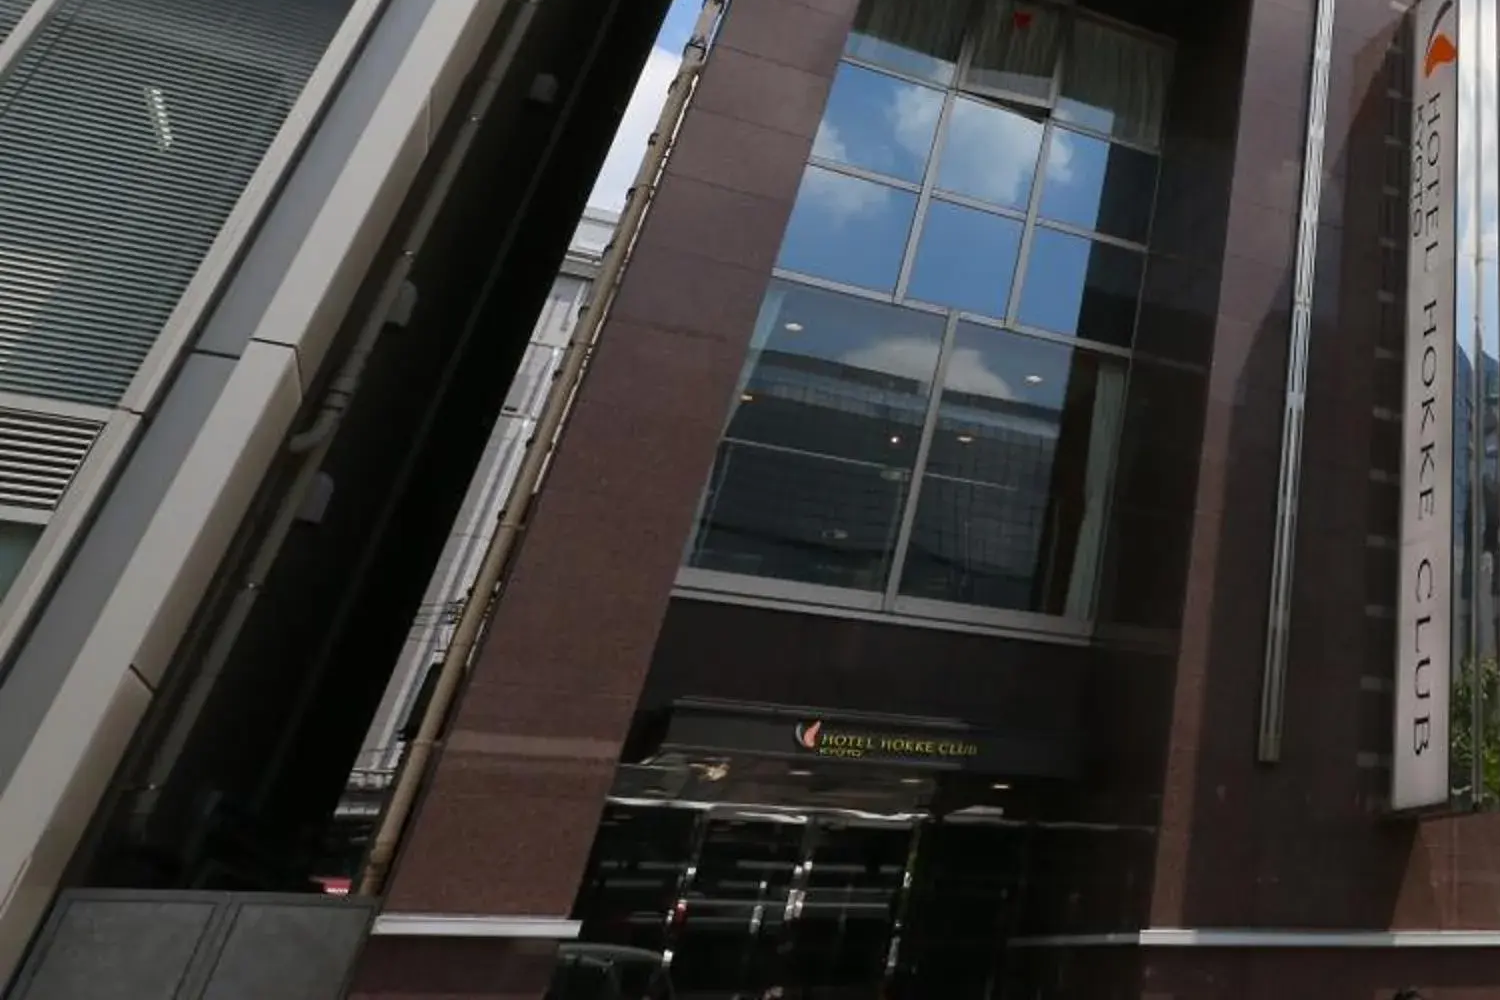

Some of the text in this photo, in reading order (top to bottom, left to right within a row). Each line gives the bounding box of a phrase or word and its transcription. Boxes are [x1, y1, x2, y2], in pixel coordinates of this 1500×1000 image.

[1413, 103, 1424, 238] KYOTO
[1414, 92, 1441, 757] HOTEL HOKKE CLUB
[821, 733, 978, 756] HOTEL HOKKE CLUB
